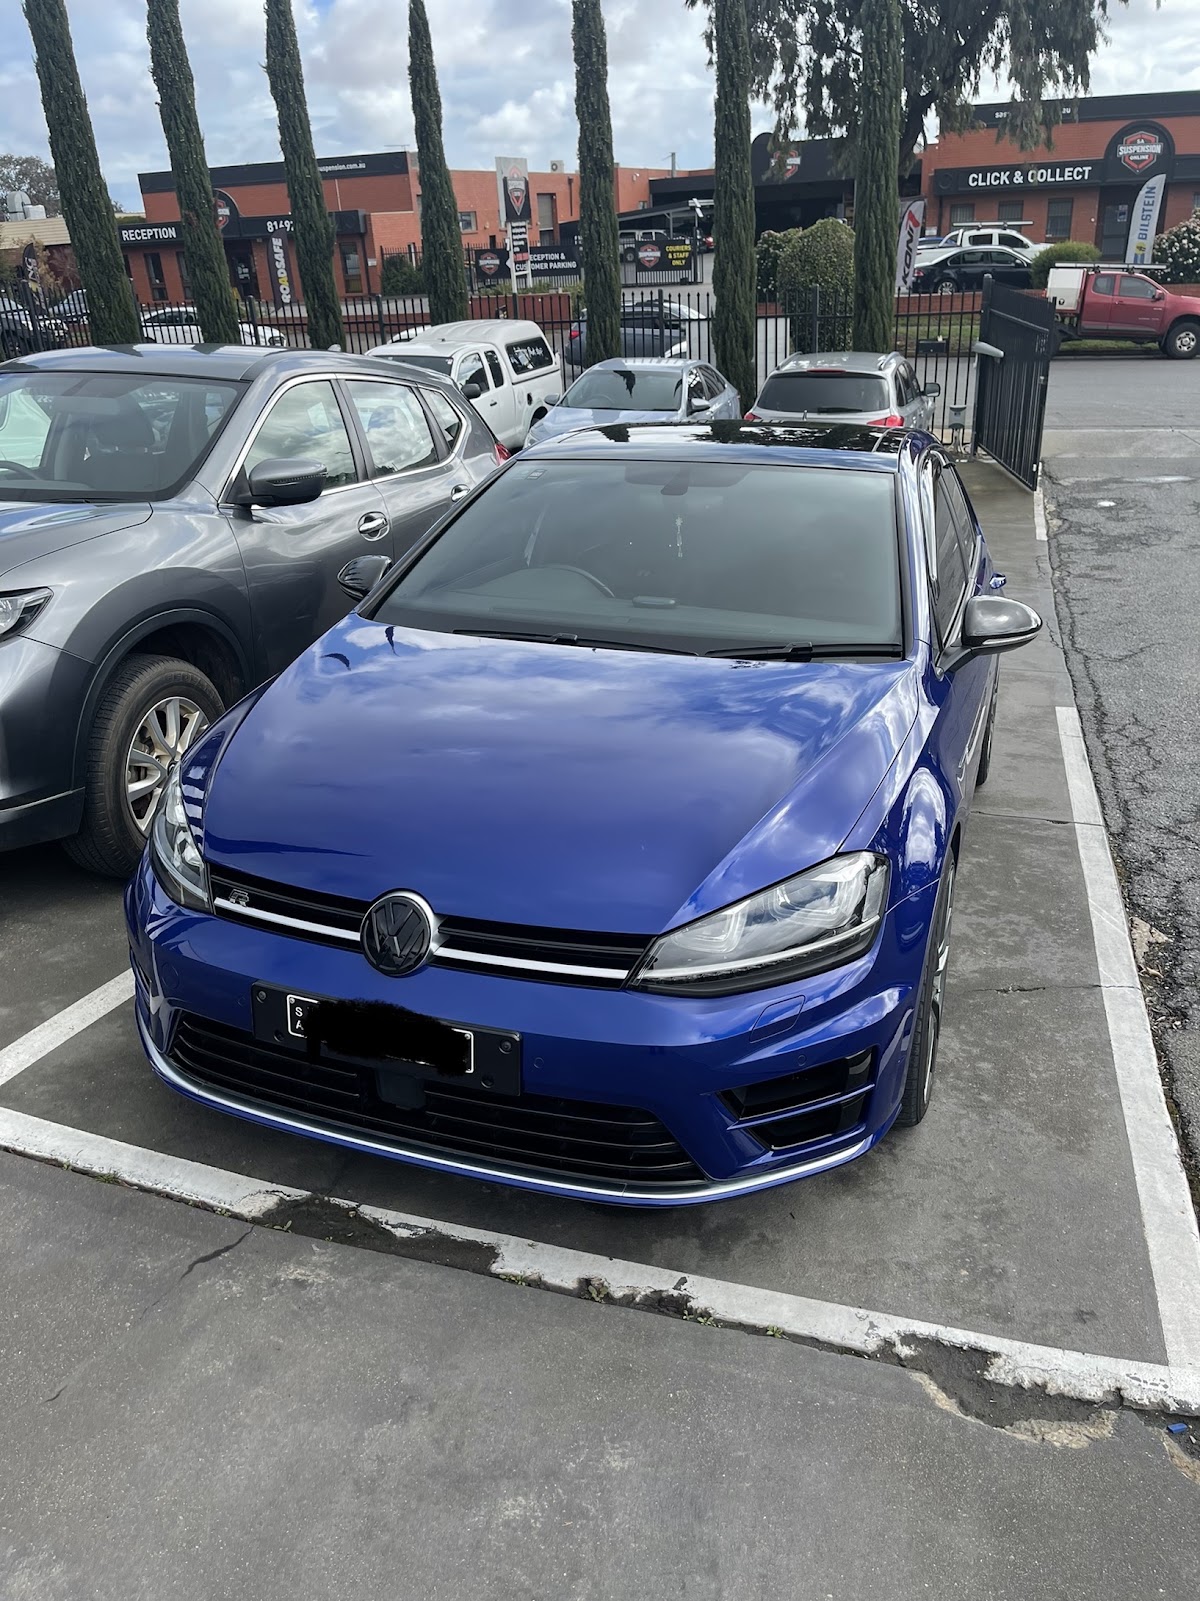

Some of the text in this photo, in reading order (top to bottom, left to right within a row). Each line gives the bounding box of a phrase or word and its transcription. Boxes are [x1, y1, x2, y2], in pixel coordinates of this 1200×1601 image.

[1118, 144, 1162, 155] SUSPENSION
[968, 166, 1092, 187] CLICK & COLLECT
[1138, 186, 1156, 240] BILSTEIN
[122, 226, 177, 242] RECEPTION
[530, 253, 559, 261] ECEPTION
[902, 214, 917, 286] KONI
[272, 238, 291, 303] ROADSAFE
[515, 261, 577, 271] CUSOMER PARKING
[295, 1006, 303, 1017] S
